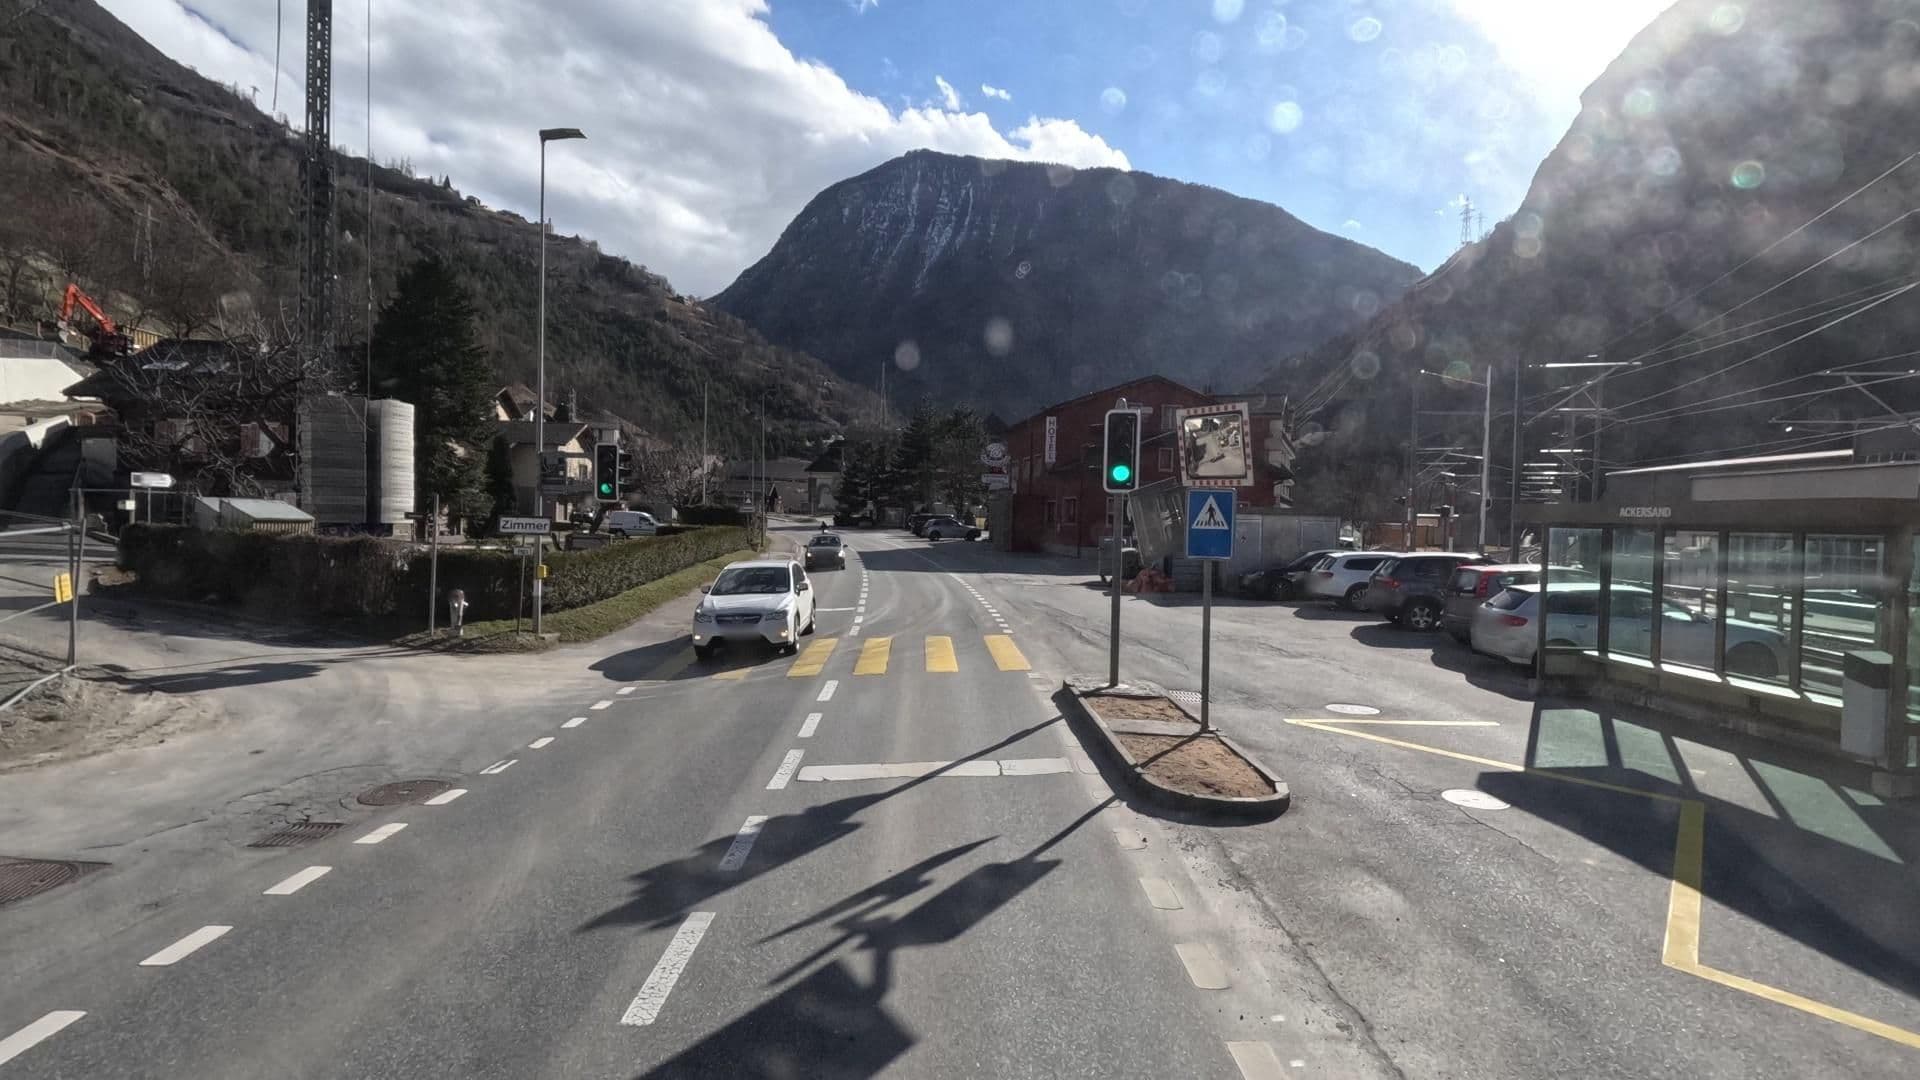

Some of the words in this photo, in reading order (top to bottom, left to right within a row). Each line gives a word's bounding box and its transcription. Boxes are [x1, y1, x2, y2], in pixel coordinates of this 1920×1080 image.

[1047, 418, 1056, 462] HOTEL
[1619, 507, 1671, 518] ACKERSAND
[502, 519, 549, 531] Zimmer
